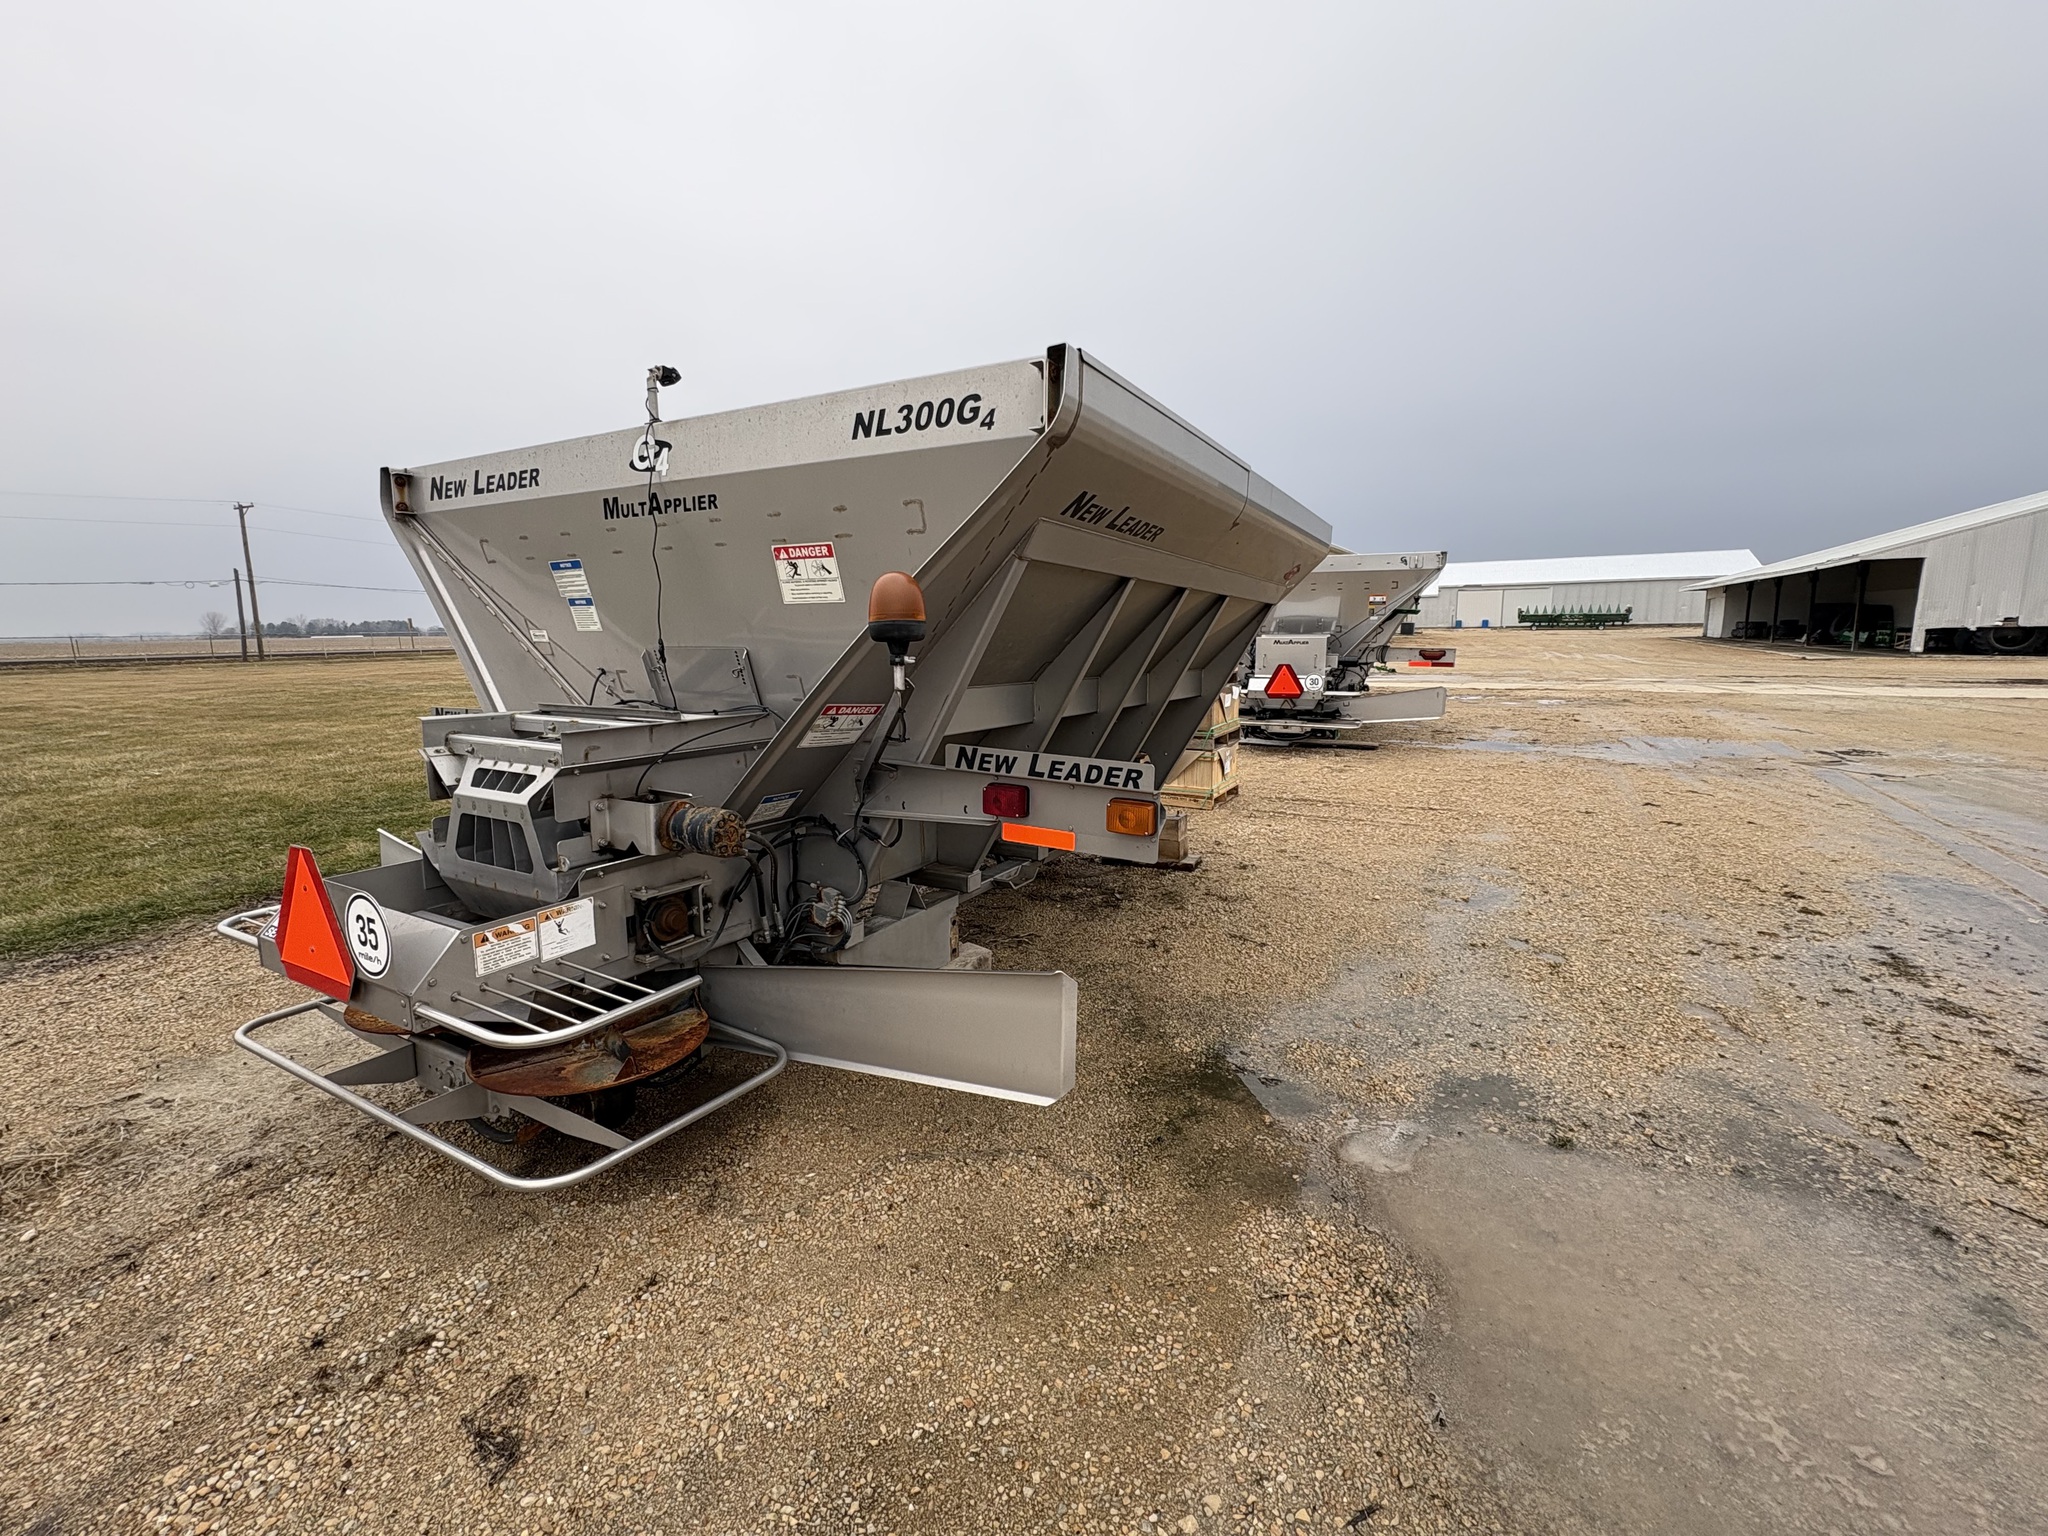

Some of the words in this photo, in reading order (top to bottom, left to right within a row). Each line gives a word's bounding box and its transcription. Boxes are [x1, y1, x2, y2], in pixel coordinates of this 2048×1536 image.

[851, 393, 996, 441] NL300G4
[430, 475, 467, 501] NEW
[473, 468, 540, 495] LEADER
[602, 492, 718, 520] MULTAPPLIER
[1060, 490, 1113, 525] NEW
[1105, 506, 1165, 542] LEADER
[788, 546, 829, 558] DANGER
[1309, 678, 1319, 686] 30
[838, 701, 877, 714] DANGER
[955, 746, 1018, 774] NEW
[1028, 753, 1143, 789] LEADER
[355, 913, 379, 951] 35
[358, 951, 382, 966] mile/h
